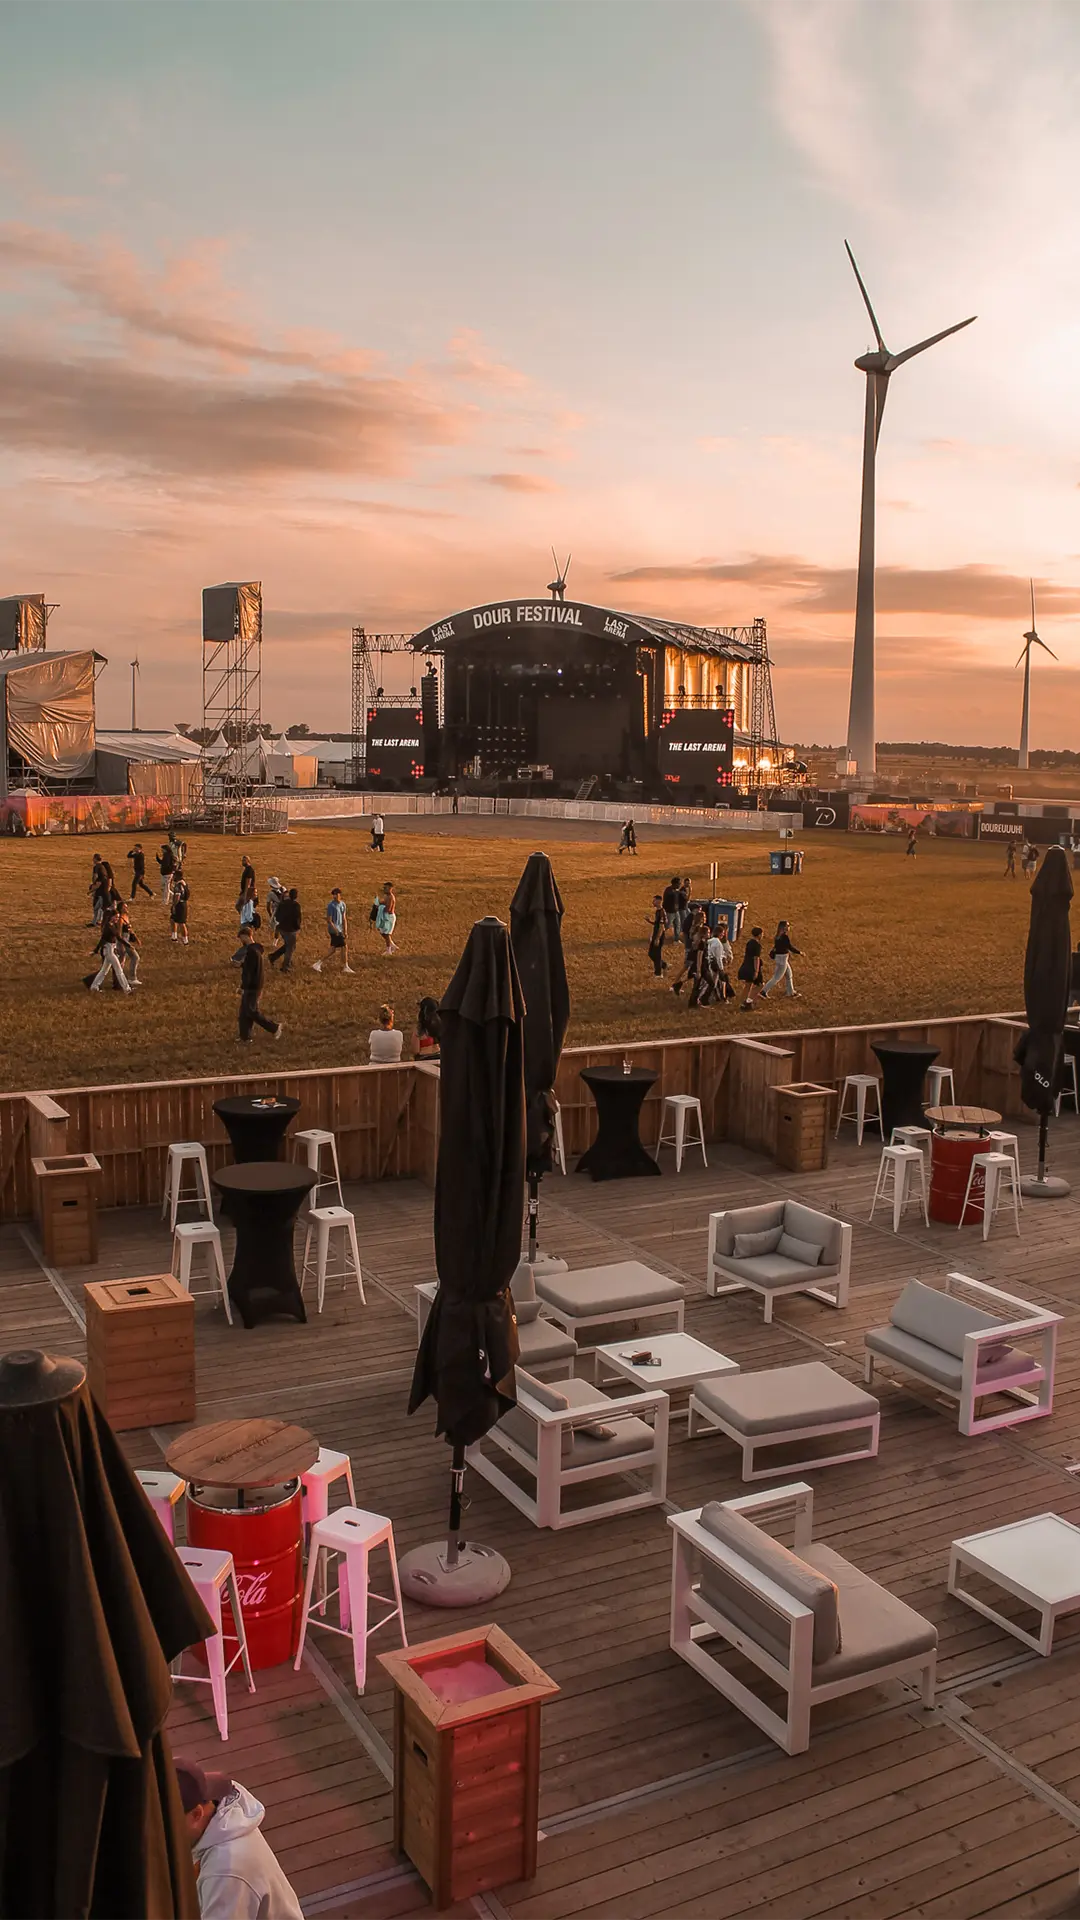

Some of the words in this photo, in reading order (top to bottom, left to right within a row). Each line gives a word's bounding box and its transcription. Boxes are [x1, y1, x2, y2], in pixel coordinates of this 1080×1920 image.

[473, 608, 511, 629] DOUR
[516, 605, 583, 626] FESTIVAL
[605, 616, 630, 632] LAST
[431, 621, 453, 638] LAST
[433, 629, 456, 643] ARENA
[603, 625, 626, 639] ARENA
[371, 738, 383, 747] THE
[383, 738, 399, 747] LAST
[399, 738, 420, 747] ARENA
[668, 742, 683, 751] THE
[683, 742, 702, 751] LAST
[702, 742, 727, 752] ARENA
